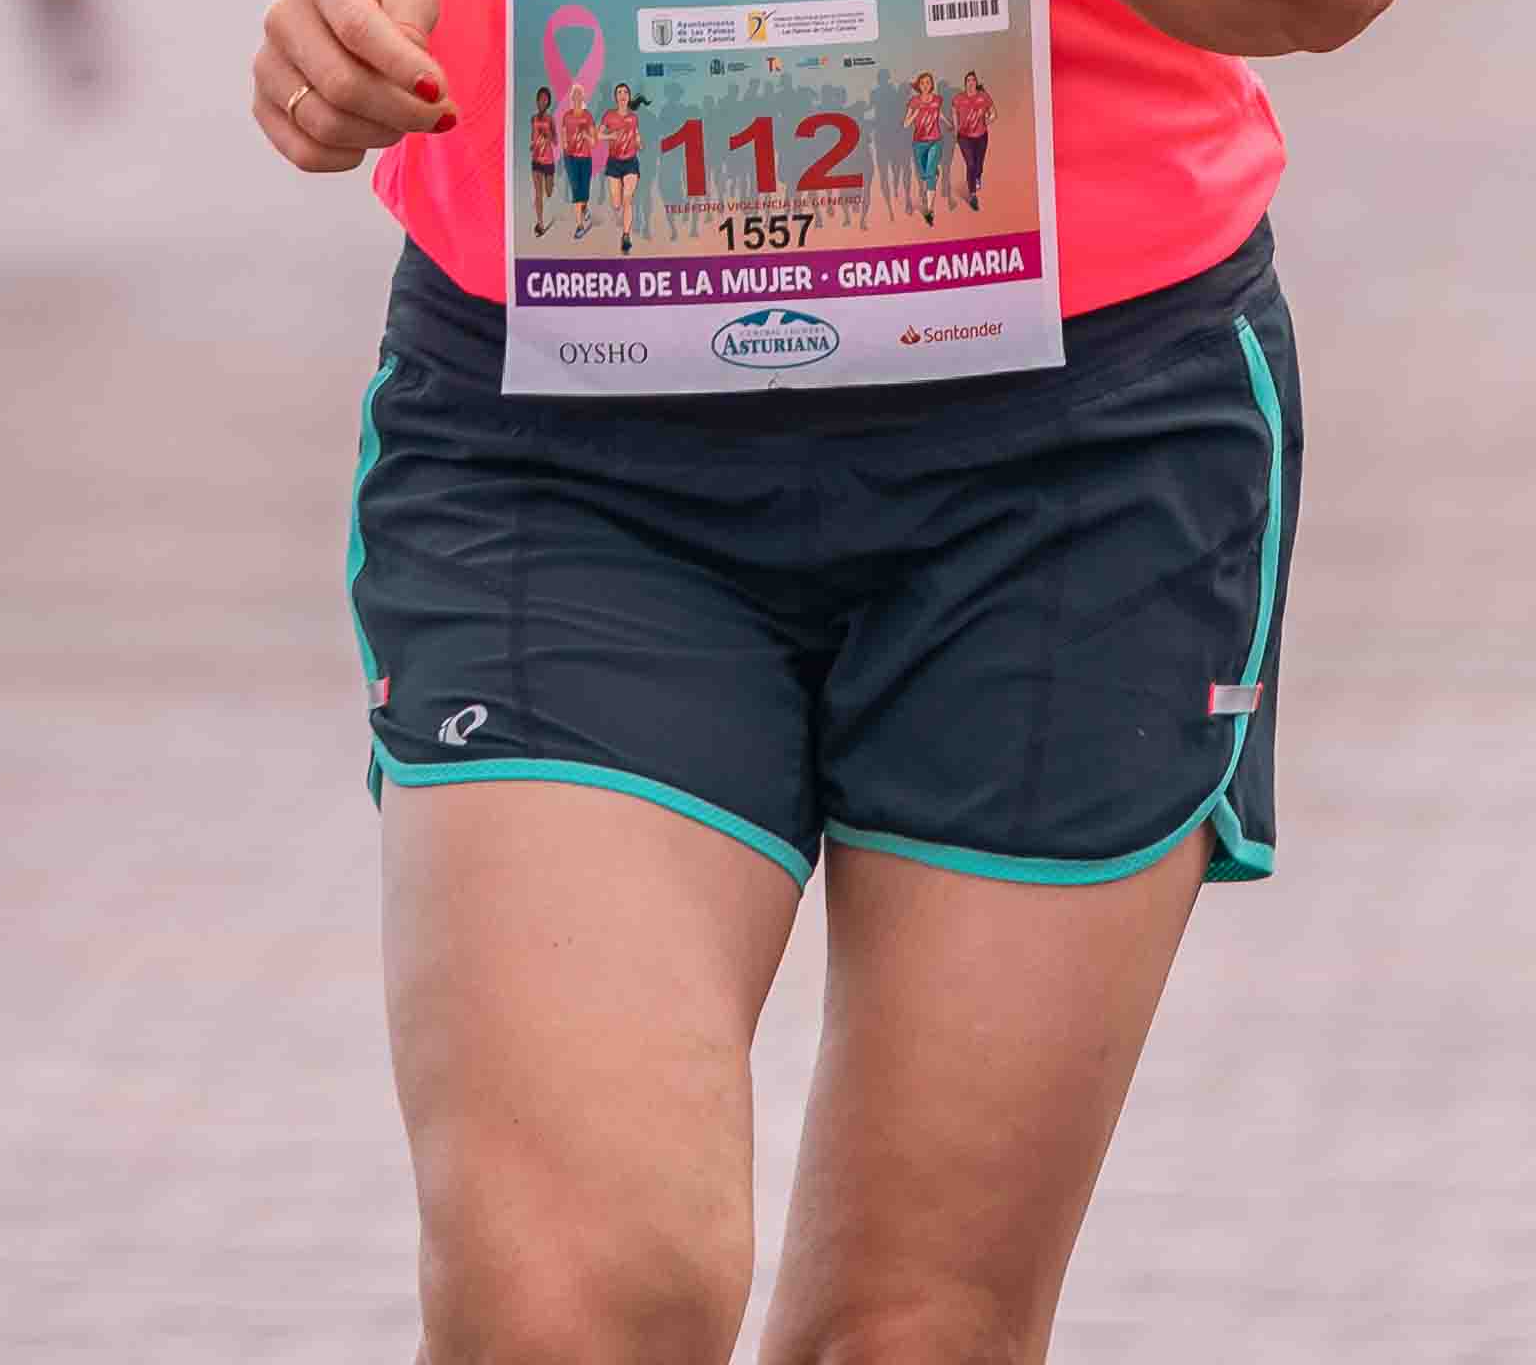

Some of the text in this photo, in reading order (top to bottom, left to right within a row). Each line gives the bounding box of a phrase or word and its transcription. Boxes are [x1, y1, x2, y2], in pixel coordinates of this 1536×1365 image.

[660, 112, 864, 196] 112
[719, 214, 814, 251] 1557
[527, 246, 1025, 298] CARRERA DE LA MUJER GRAN CANARIA
[722, 333, 831, 357] ASTURIANA
[923, 321, 1004, 343] Santander
[559, 342, 648, 365] OYSHO
